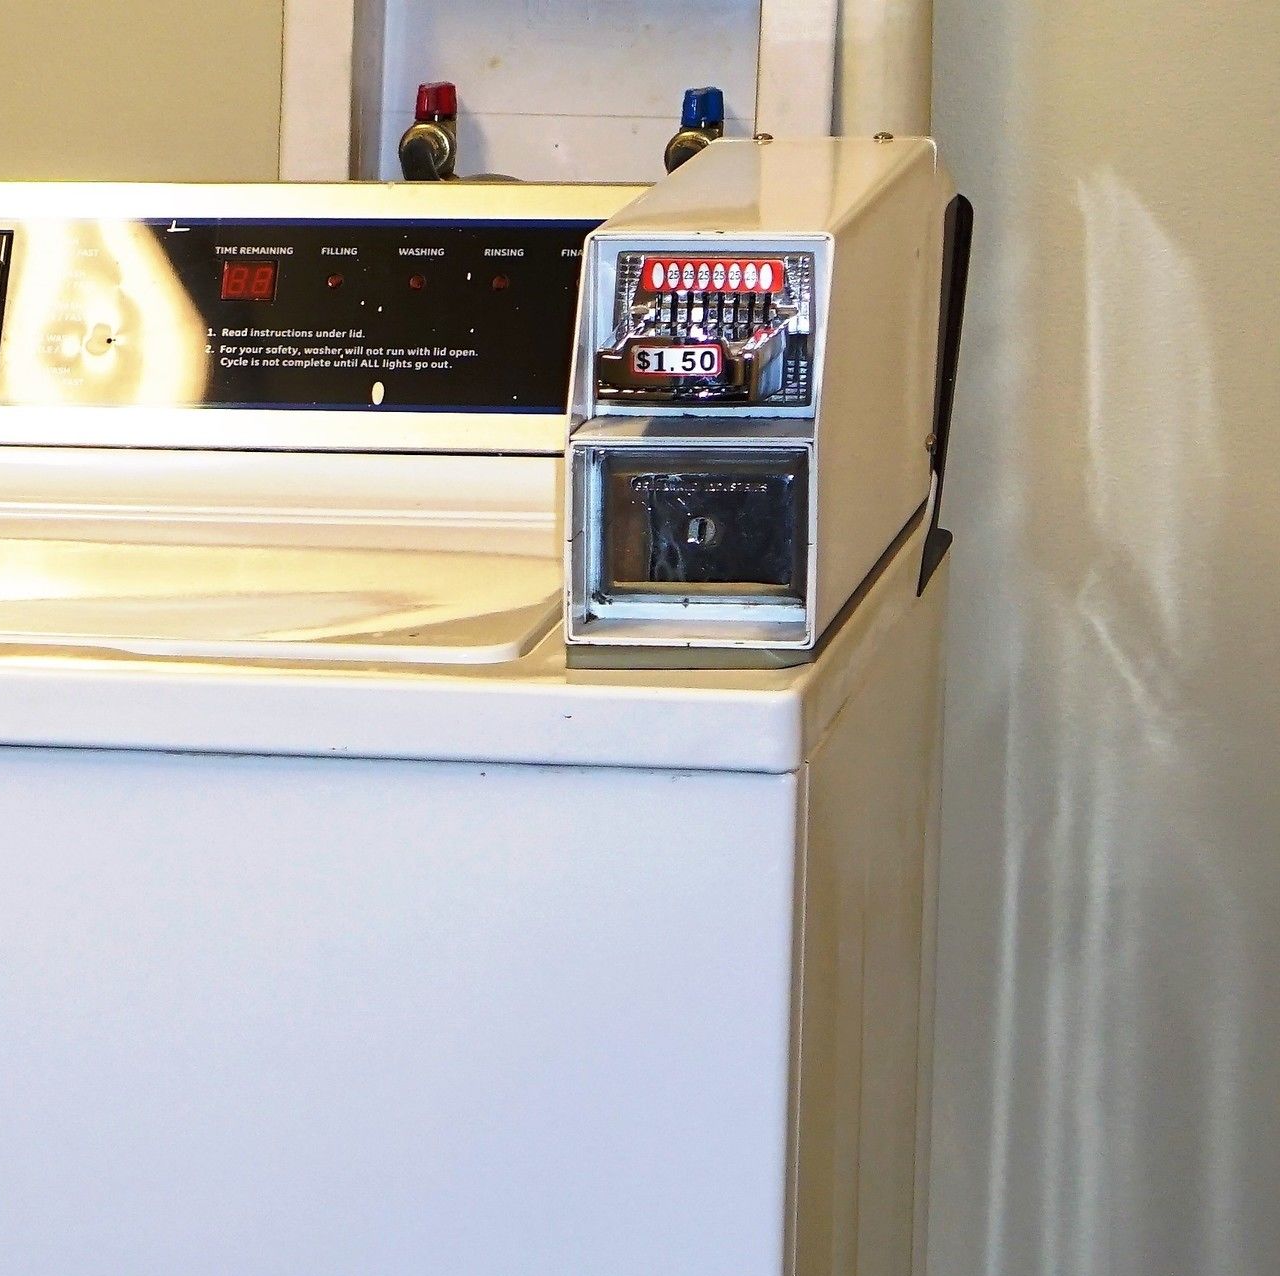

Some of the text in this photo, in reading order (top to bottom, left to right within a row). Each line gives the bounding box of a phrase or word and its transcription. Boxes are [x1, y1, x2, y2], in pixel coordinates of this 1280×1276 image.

[215, 246, 294, 255] TIME REMAINING
[321, 247, 358, 256] FILLING
[399, 248, 445, 256] WASHING
[484, 248, 524, 257] RINSING
[561, 249, 583, 257] FINA
[207, 328, 366, 338] 1. Read instructions under lid.
[205, 345, 479, 358] 2. For your safety, washer will not run with lid open.
[220, 357, 453, 370] Cycle is not complete until ALL lights go out.
[636, 350, 716, 372] $1.50
